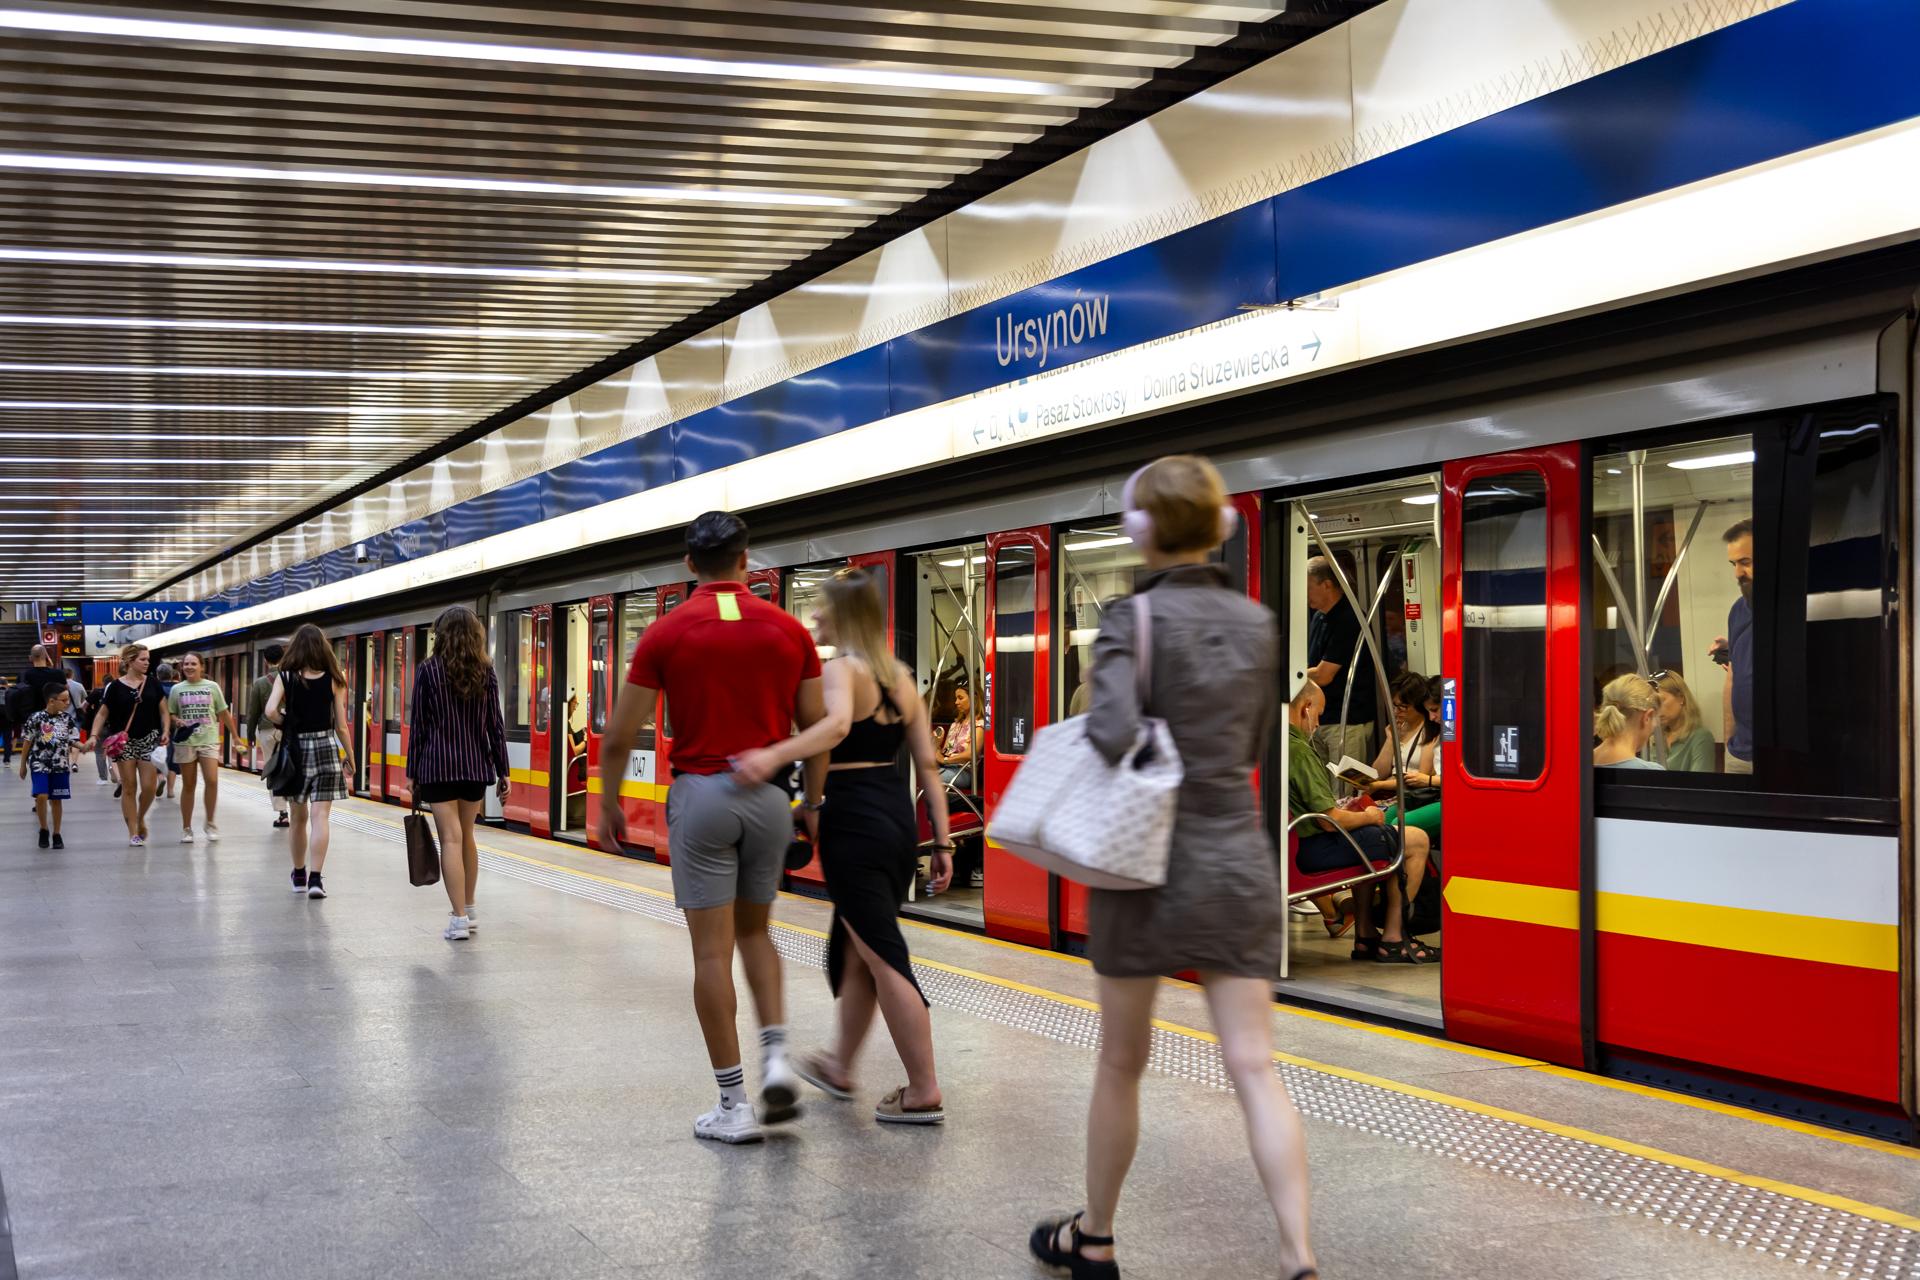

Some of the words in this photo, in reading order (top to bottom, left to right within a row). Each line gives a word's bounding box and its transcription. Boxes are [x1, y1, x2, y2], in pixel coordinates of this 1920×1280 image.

[996, 289, 1109, 367] Ursynów
[1143, 371, 1186, 401] Dolina
[112, 607, 169, 623] Kabaty
[632, 756, 646, 777] 1047
